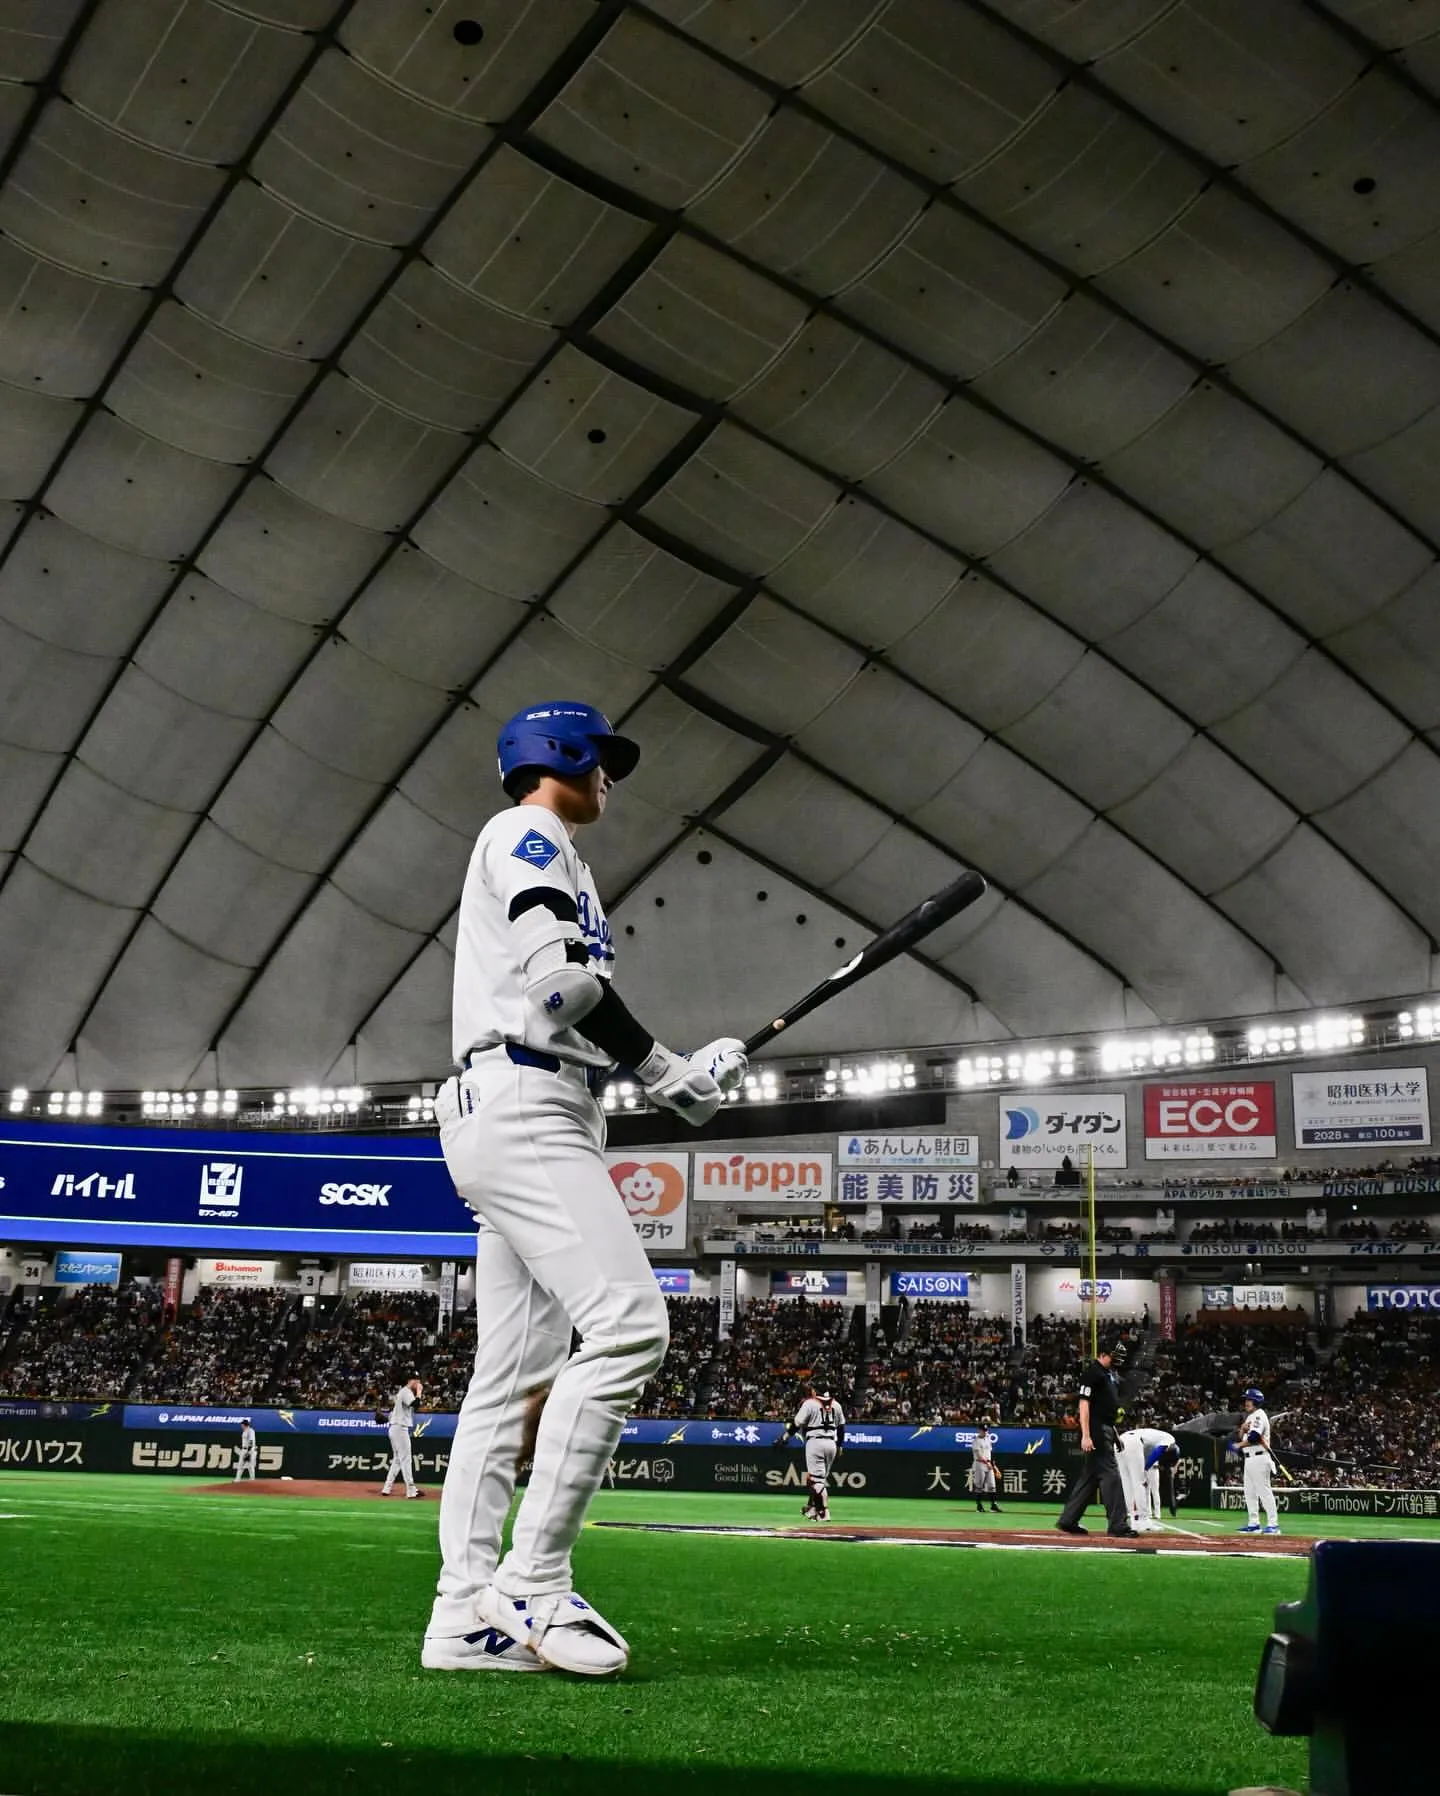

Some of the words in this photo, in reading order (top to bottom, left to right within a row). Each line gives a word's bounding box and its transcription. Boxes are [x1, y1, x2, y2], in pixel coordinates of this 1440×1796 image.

[1327, 1082, 1420, 1098] 昭和医科大学
[1045, 1112, 1121, 1134] ダイダン
[1159, 1098, 1259, 1134] ECC
[864, 1138, 969, 1156] あんしん財団
[703, 1155, 822, 1192] nippn
[51, 1172, 136, 1199] バイトル
[842, 1174, 975, 1200] 能美防災
[1322, 1181, 1384, 1197] DUSKIN
[319, 1183, 392, 1206] SCSK
[25, 1266, 39, 1278] 34
[306, 1276, 314, 1286] 3
[897, 1277, 961, 1292] SAISON
[1207, 1289, 1228, 1304] JR
[171, 1414, 204, 1423] JAPAN
[844, 1432, 882, 1443] Fujikura
[955, 1432, 998, 1443] SEO
[765, 1461, 866, 1489] SAYO
[1322, 1493, 1369, 1511] Tombow
[1374, 1494, 1437, 1514] トンボ鉛筆
